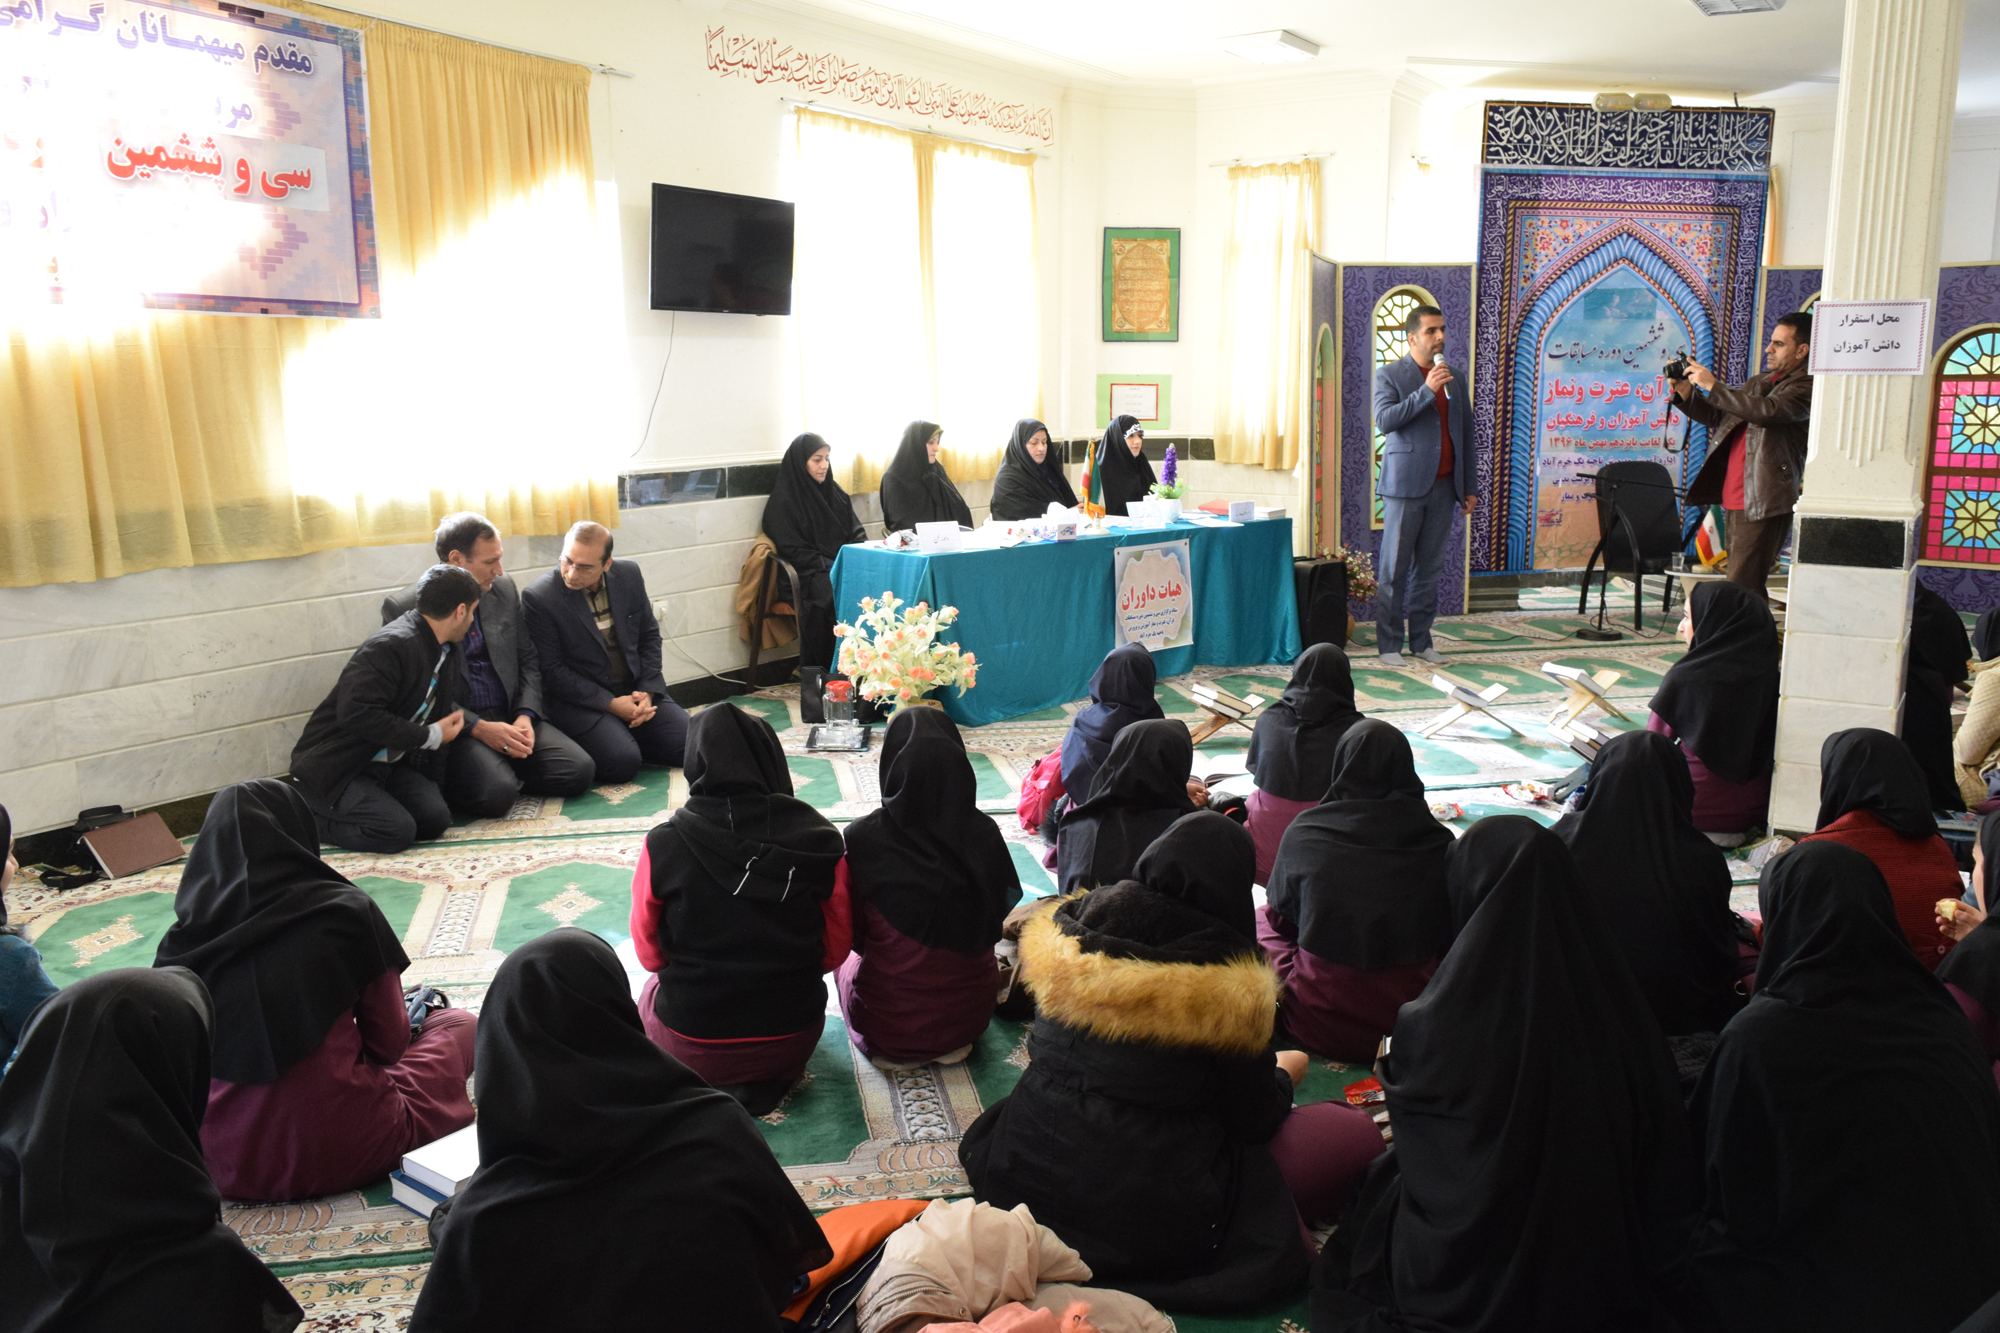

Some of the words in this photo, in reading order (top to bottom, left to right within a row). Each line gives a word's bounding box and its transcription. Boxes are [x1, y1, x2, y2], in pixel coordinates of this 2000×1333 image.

[116, 10, 246, 66] میهمانان
[254, 41, 313, 74] مقدم
[233, 156, 251, 194] و
[260, 168, 312, 198] سی
[1838, 313, 1875, 327] استقرار
[1876, 313, 1900, 326] محل
[1548, 341, 1597, 365] مسابقات
[1598, 346, 1622, 360] دوره
[1833, 338, 1870, 353] آموزان
[1872, 339, 1901, 353] دانش
[1589, 380, 1631, 403] عترت
[1546, 411, 1597, 430] فرهنگیان
[1598, 416, 1606, 430] و
[1607, 410, 1649, 429] آموزان
[1574, 438, 1586, 447] ماه
[1588, 440, 1607, 450] بهمن
[1609, 437, 1638, 450] پانزدهم
[1640, 437, 1661, 448] لغایت
[1122, 584, 1156, 611] داوران
[1158, 580, 1182, 601] هیات
